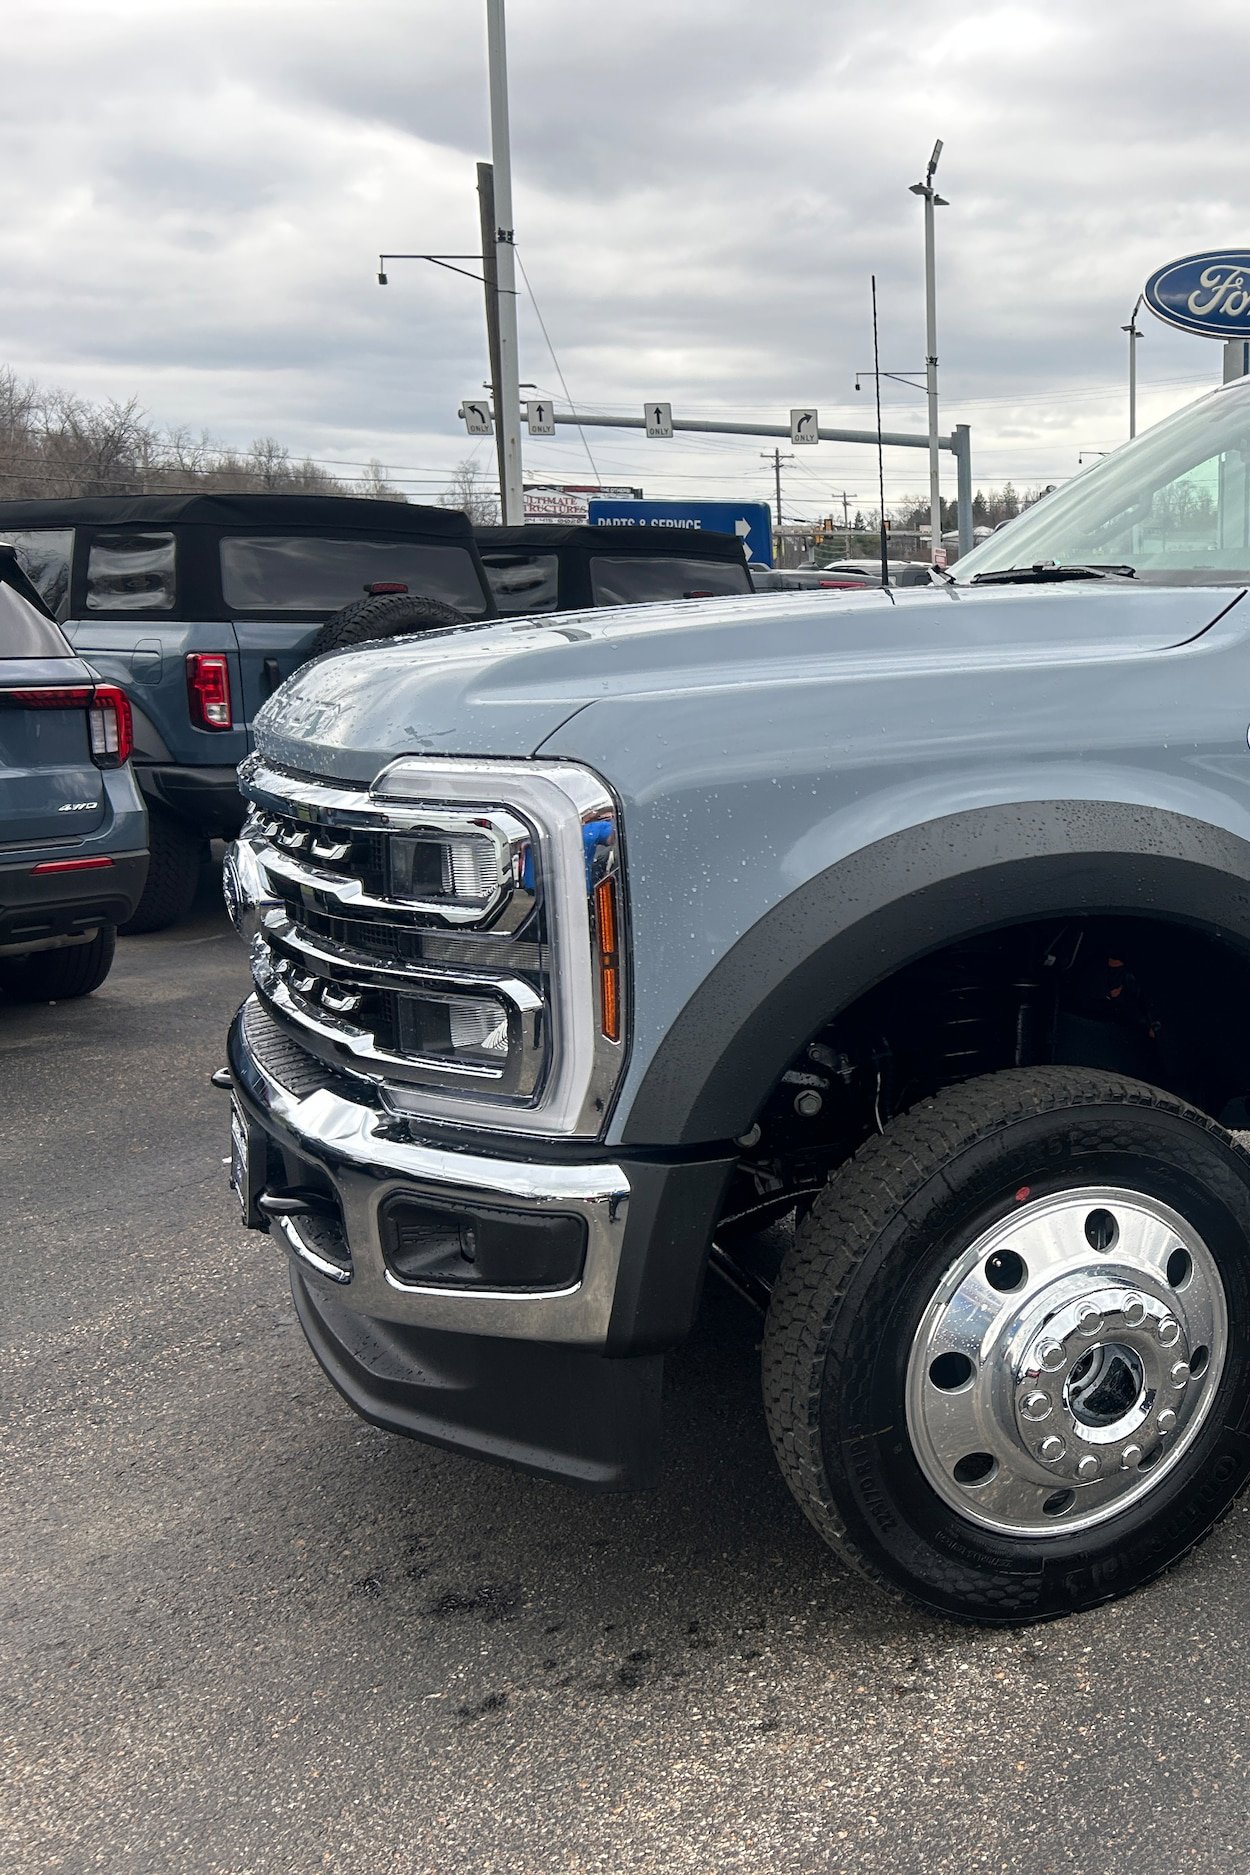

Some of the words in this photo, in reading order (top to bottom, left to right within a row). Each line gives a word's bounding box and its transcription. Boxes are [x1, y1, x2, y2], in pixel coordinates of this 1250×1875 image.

[470, 425, 490, 433] ONLY
[531, 425, 552, 433] ONLY
[794, 434, 815, 442] ONLY
[523, 504, 587, 513] TRUCTURES
[58, 801, 98, 812] 4WD
